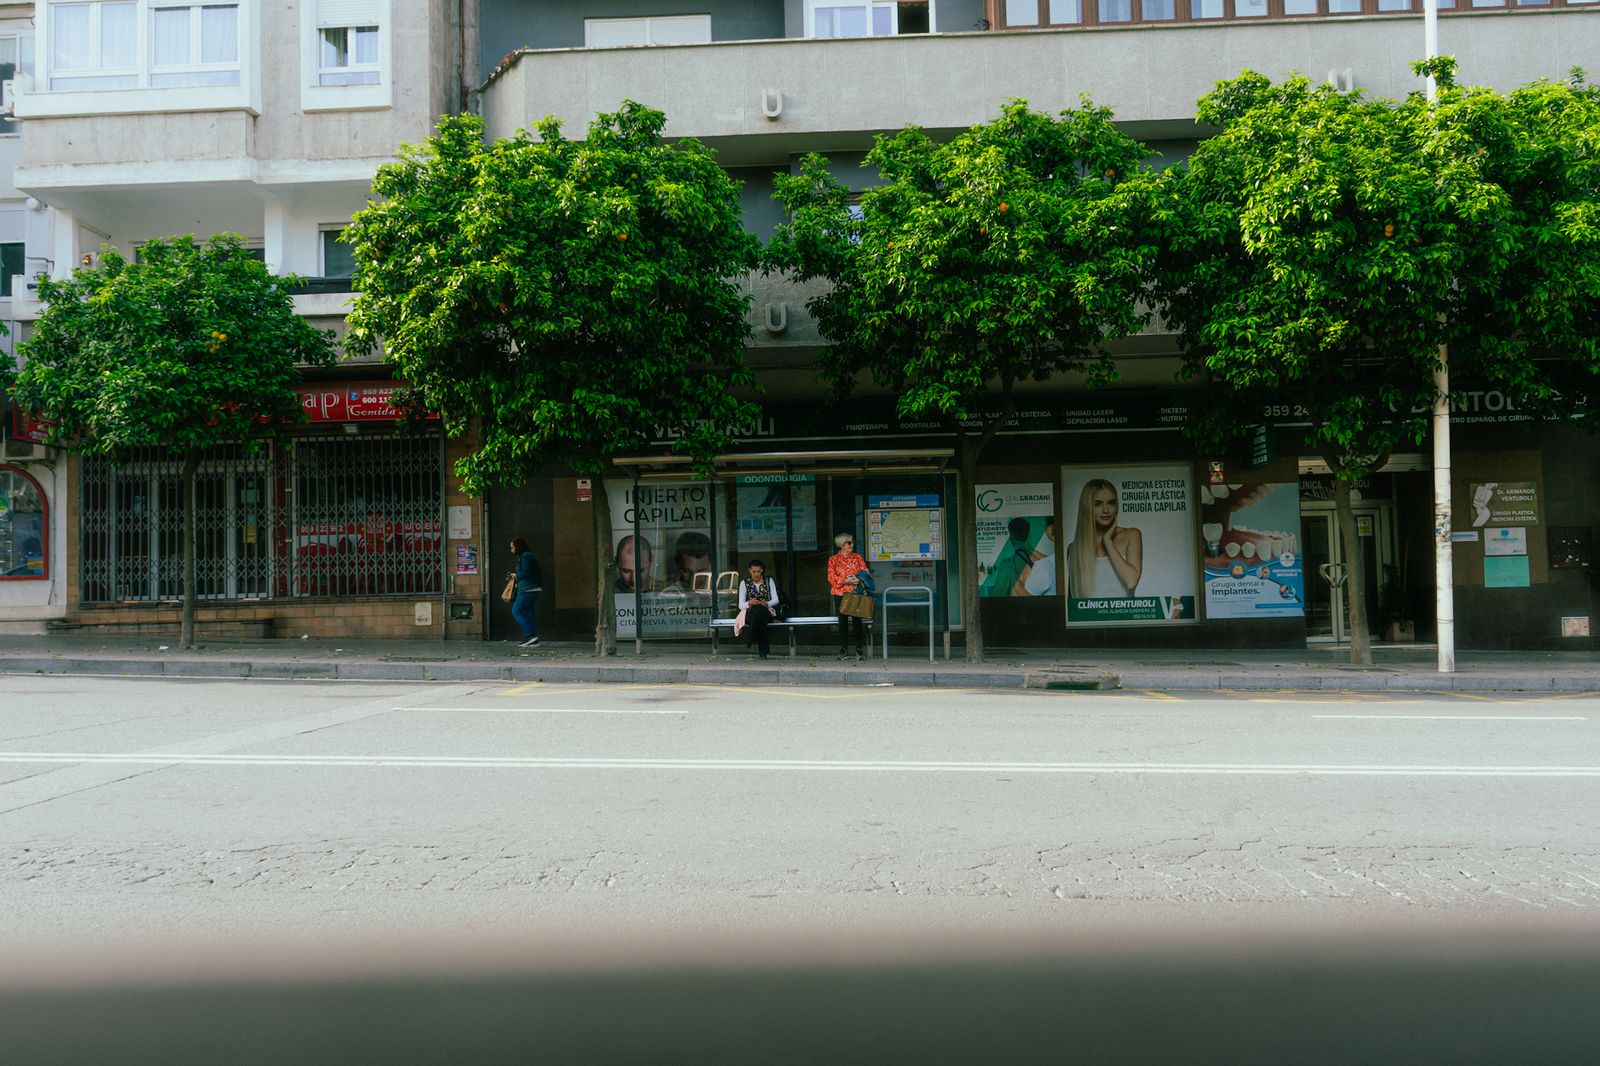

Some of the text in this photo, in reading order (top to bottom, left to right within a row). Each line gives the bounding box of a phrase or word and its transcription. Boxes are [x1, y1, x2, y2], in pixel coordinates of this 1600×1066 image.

[1066, 408, 1114, 417] UNIDAD LASER
[1106, 416, 1128, 424] LASER
[1121, 478, 1186, 490] MEDICINA ESTÉTICA
[1121, 489, 1186, 501] CIRUGÍA PLÁSTICA
[1122, 501, 1186, 513] CIRUGÍA CAPILAR
[624, 506, 706, 523] CAPILAR
[1212, 588, 1261, 597] Implantes.
[1077, 599, 1156, 610] CLÍNICA VENTUROLI
